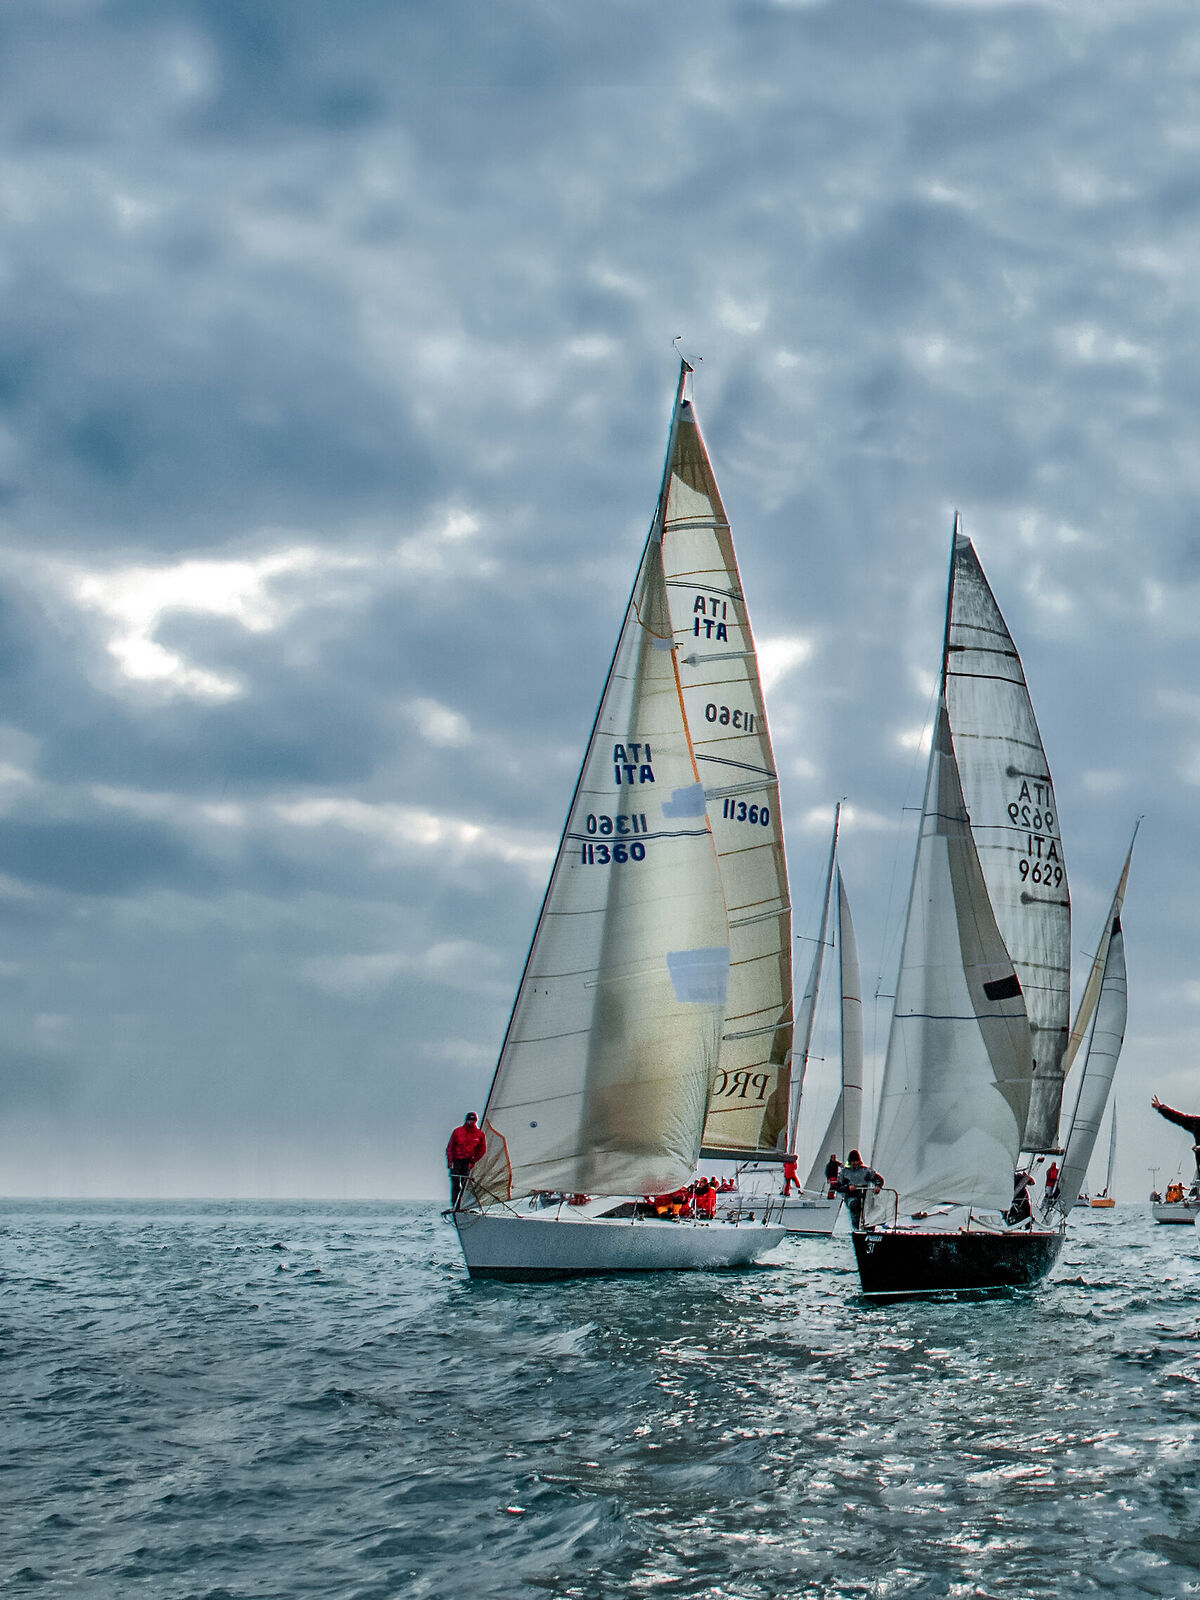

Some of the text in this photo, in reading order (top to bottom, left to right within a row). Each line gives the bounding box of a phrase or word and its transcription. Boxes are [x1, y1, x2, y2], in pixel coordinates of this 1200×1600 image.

[694, 616, 728, 642] ITA
[614, 764, 655, 785] ITA
[723, 798, 770, 827] 11360
[581, 842, 646, 865] 11360
[1028, 834, 1060, 863] ITA
[1019, 859, 1063, 888] 9629
